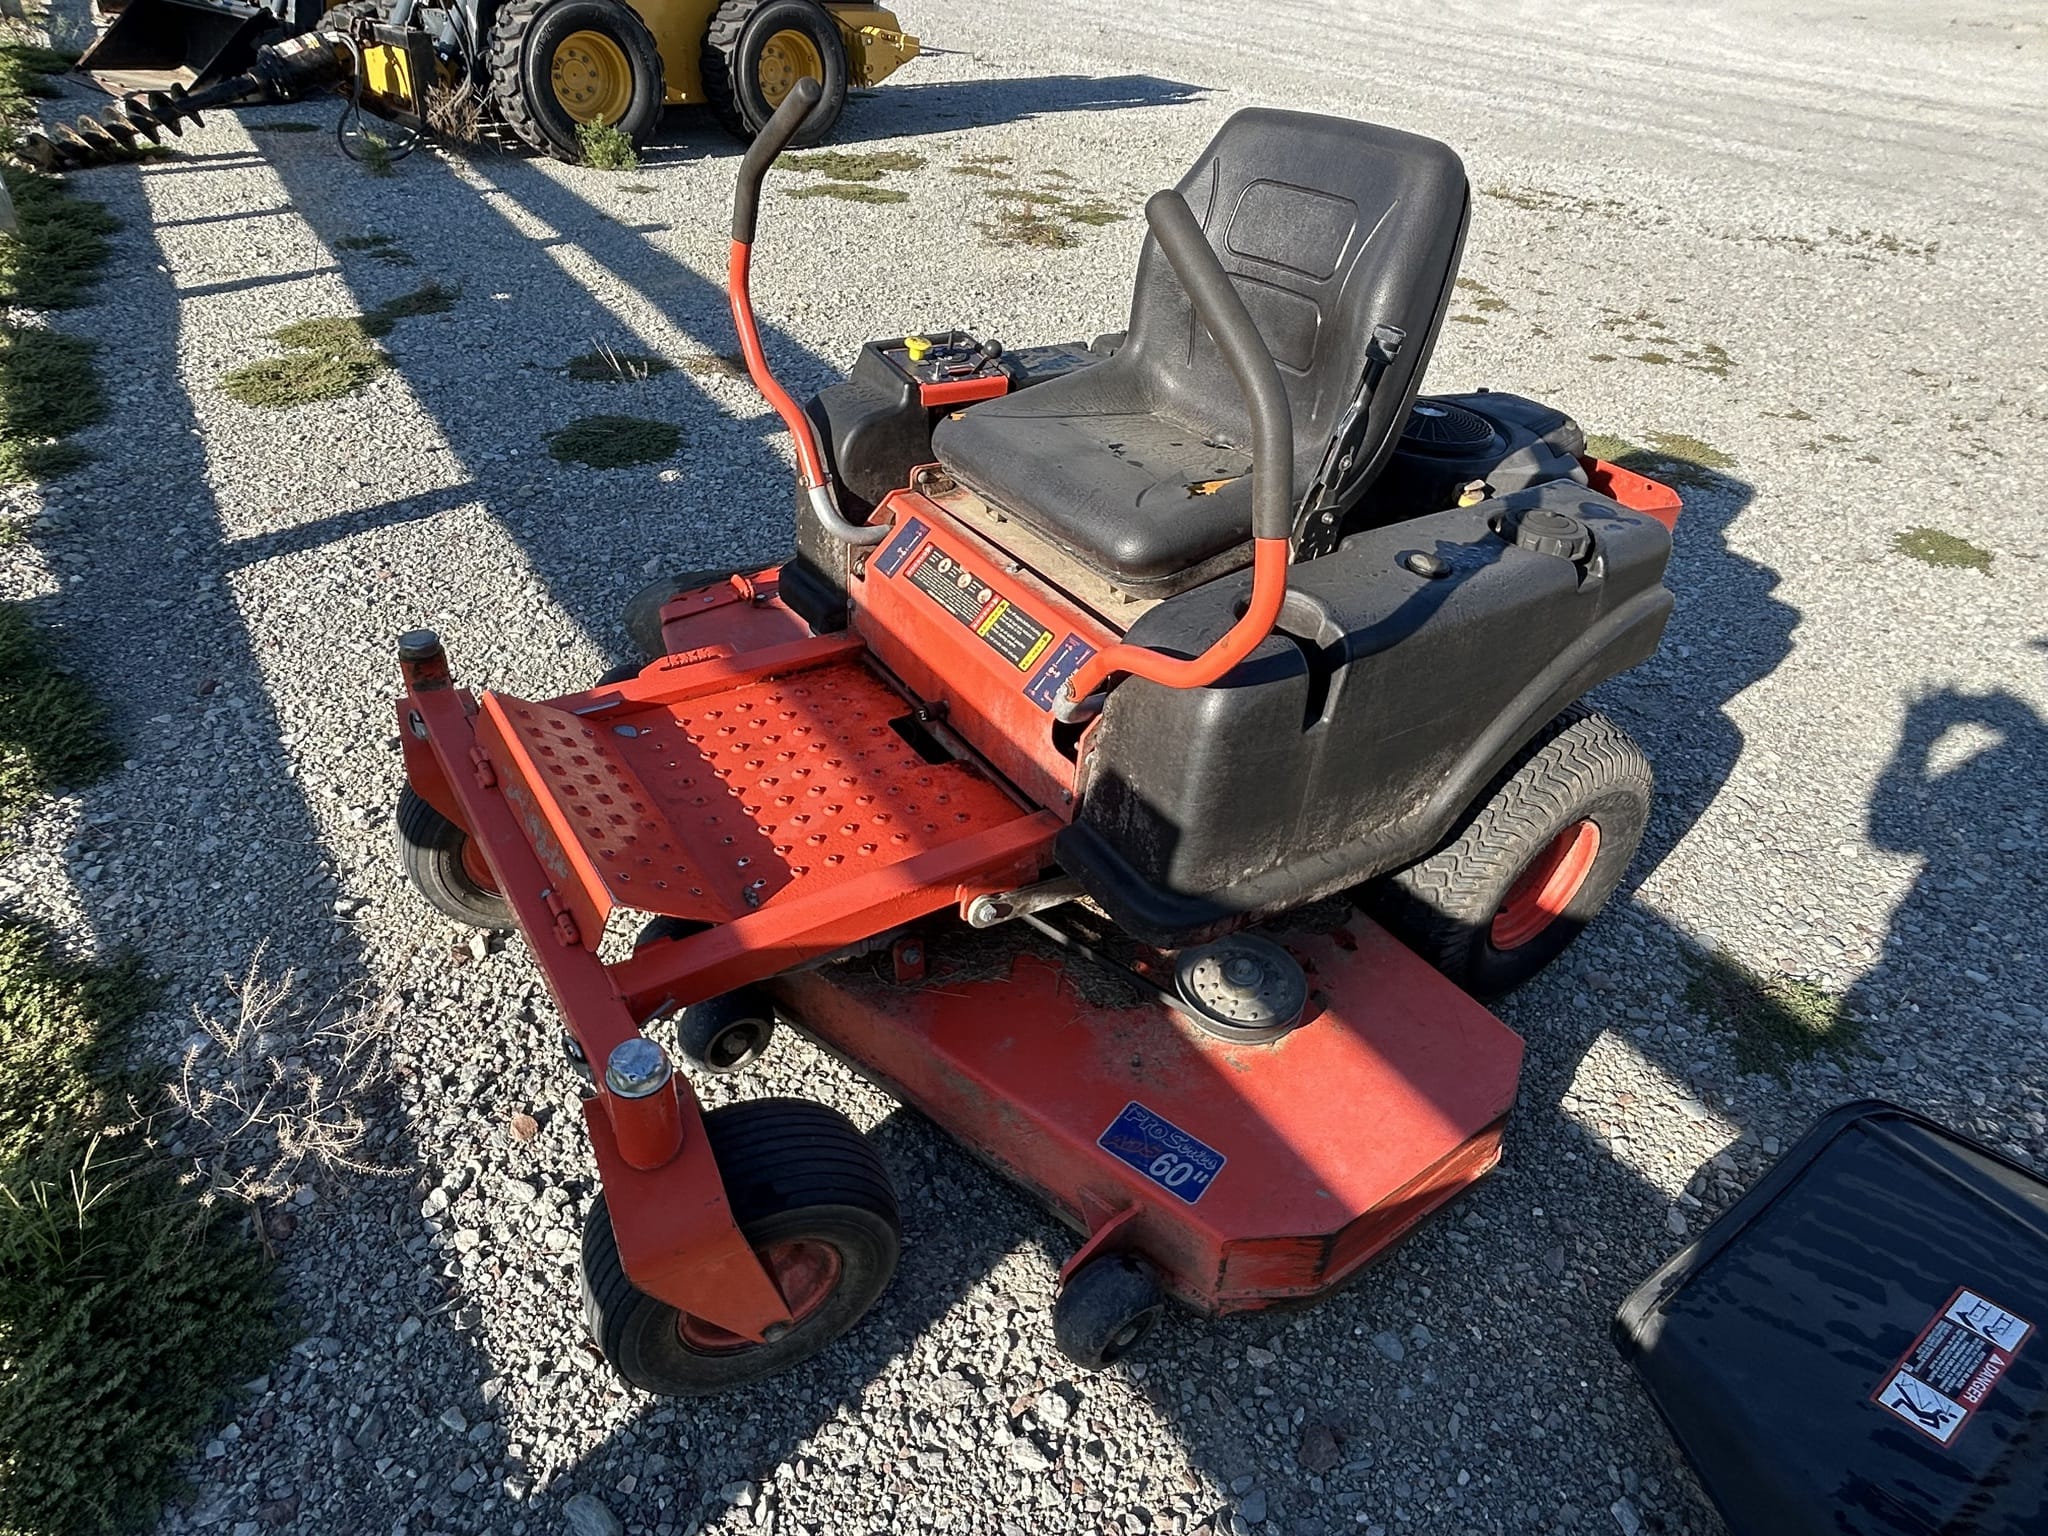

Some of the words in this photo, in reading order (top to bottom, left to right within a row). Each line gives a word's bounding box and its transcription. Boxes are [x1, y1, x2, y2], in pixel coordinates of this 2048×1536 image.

[1124, 1106, 1168, 1139] Pro
[1162, 1131, 1218, 1170] Series
[1149, 1153, 1209, 1186] 60"
[1963, 1362, 1999, 1403] DANGER
